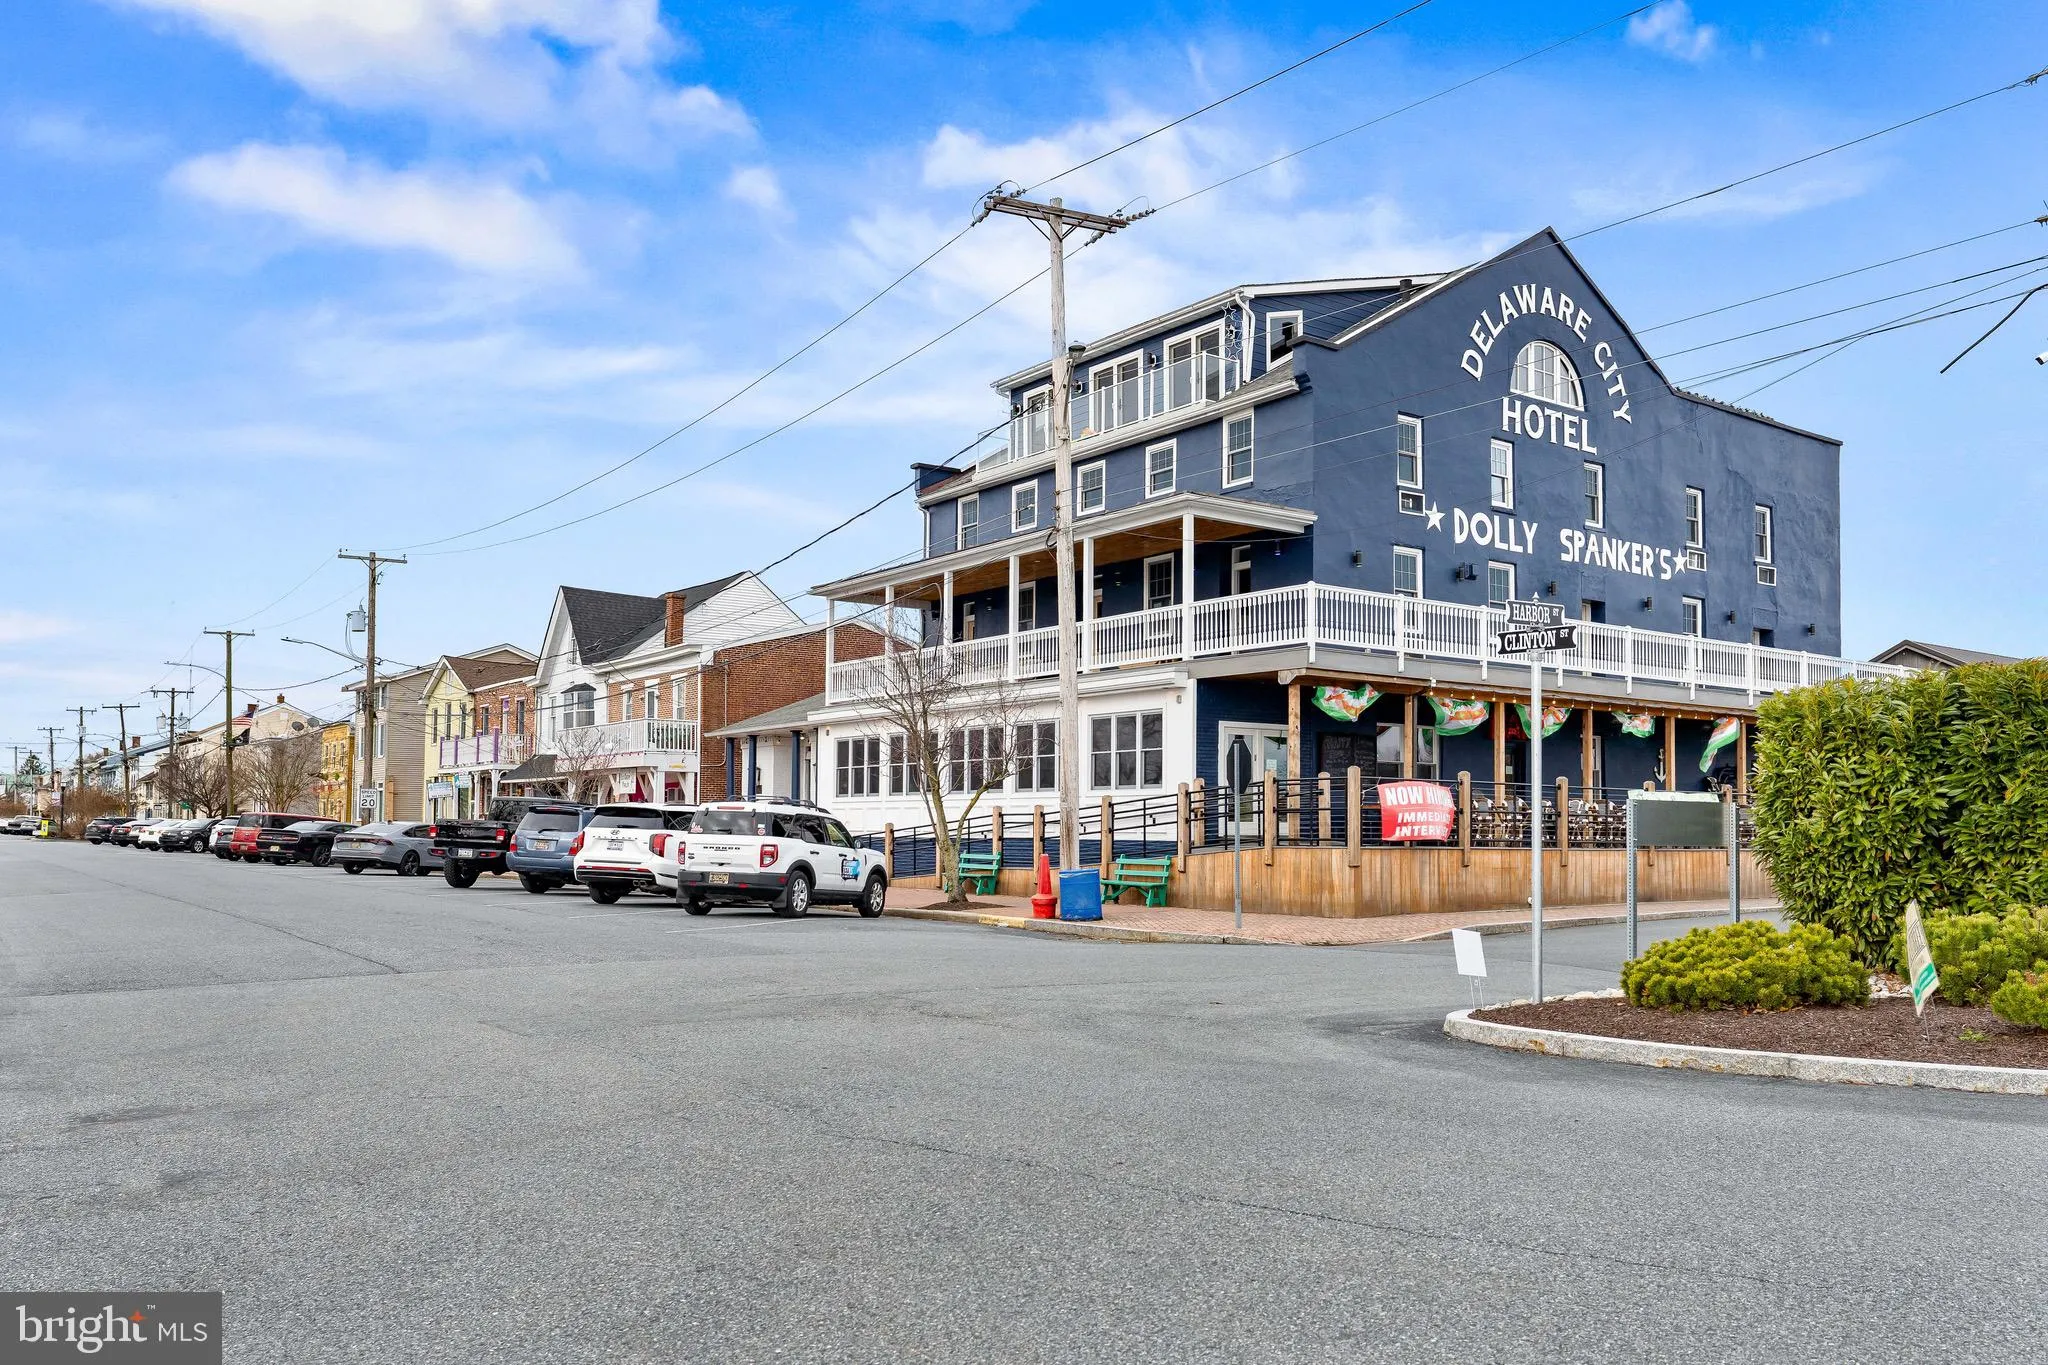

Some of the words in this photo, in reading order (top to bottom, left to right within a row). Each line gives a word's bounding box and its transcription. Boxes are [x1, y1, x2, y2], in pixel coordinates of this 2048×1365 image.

[1461, 284, 1592, 381] DELAWARE
[1594, 341, 1632, 424] CITY
[1502, 397, 1597, 455] HOTEL
[1453, 507, 1538, 554] DOLLY
[1560, 529, 1672, 580] SPANKER'S
[1513, 604, 1550, 624] HARBOR
[1553, 608, 1559, 616] ST
[1504, 630, 1556, 651] CLINTON
[1560, 629, 1569, 637] ST
[361, 798, 375, 807] 20
[1385, 786, 1424, 806] NOW
